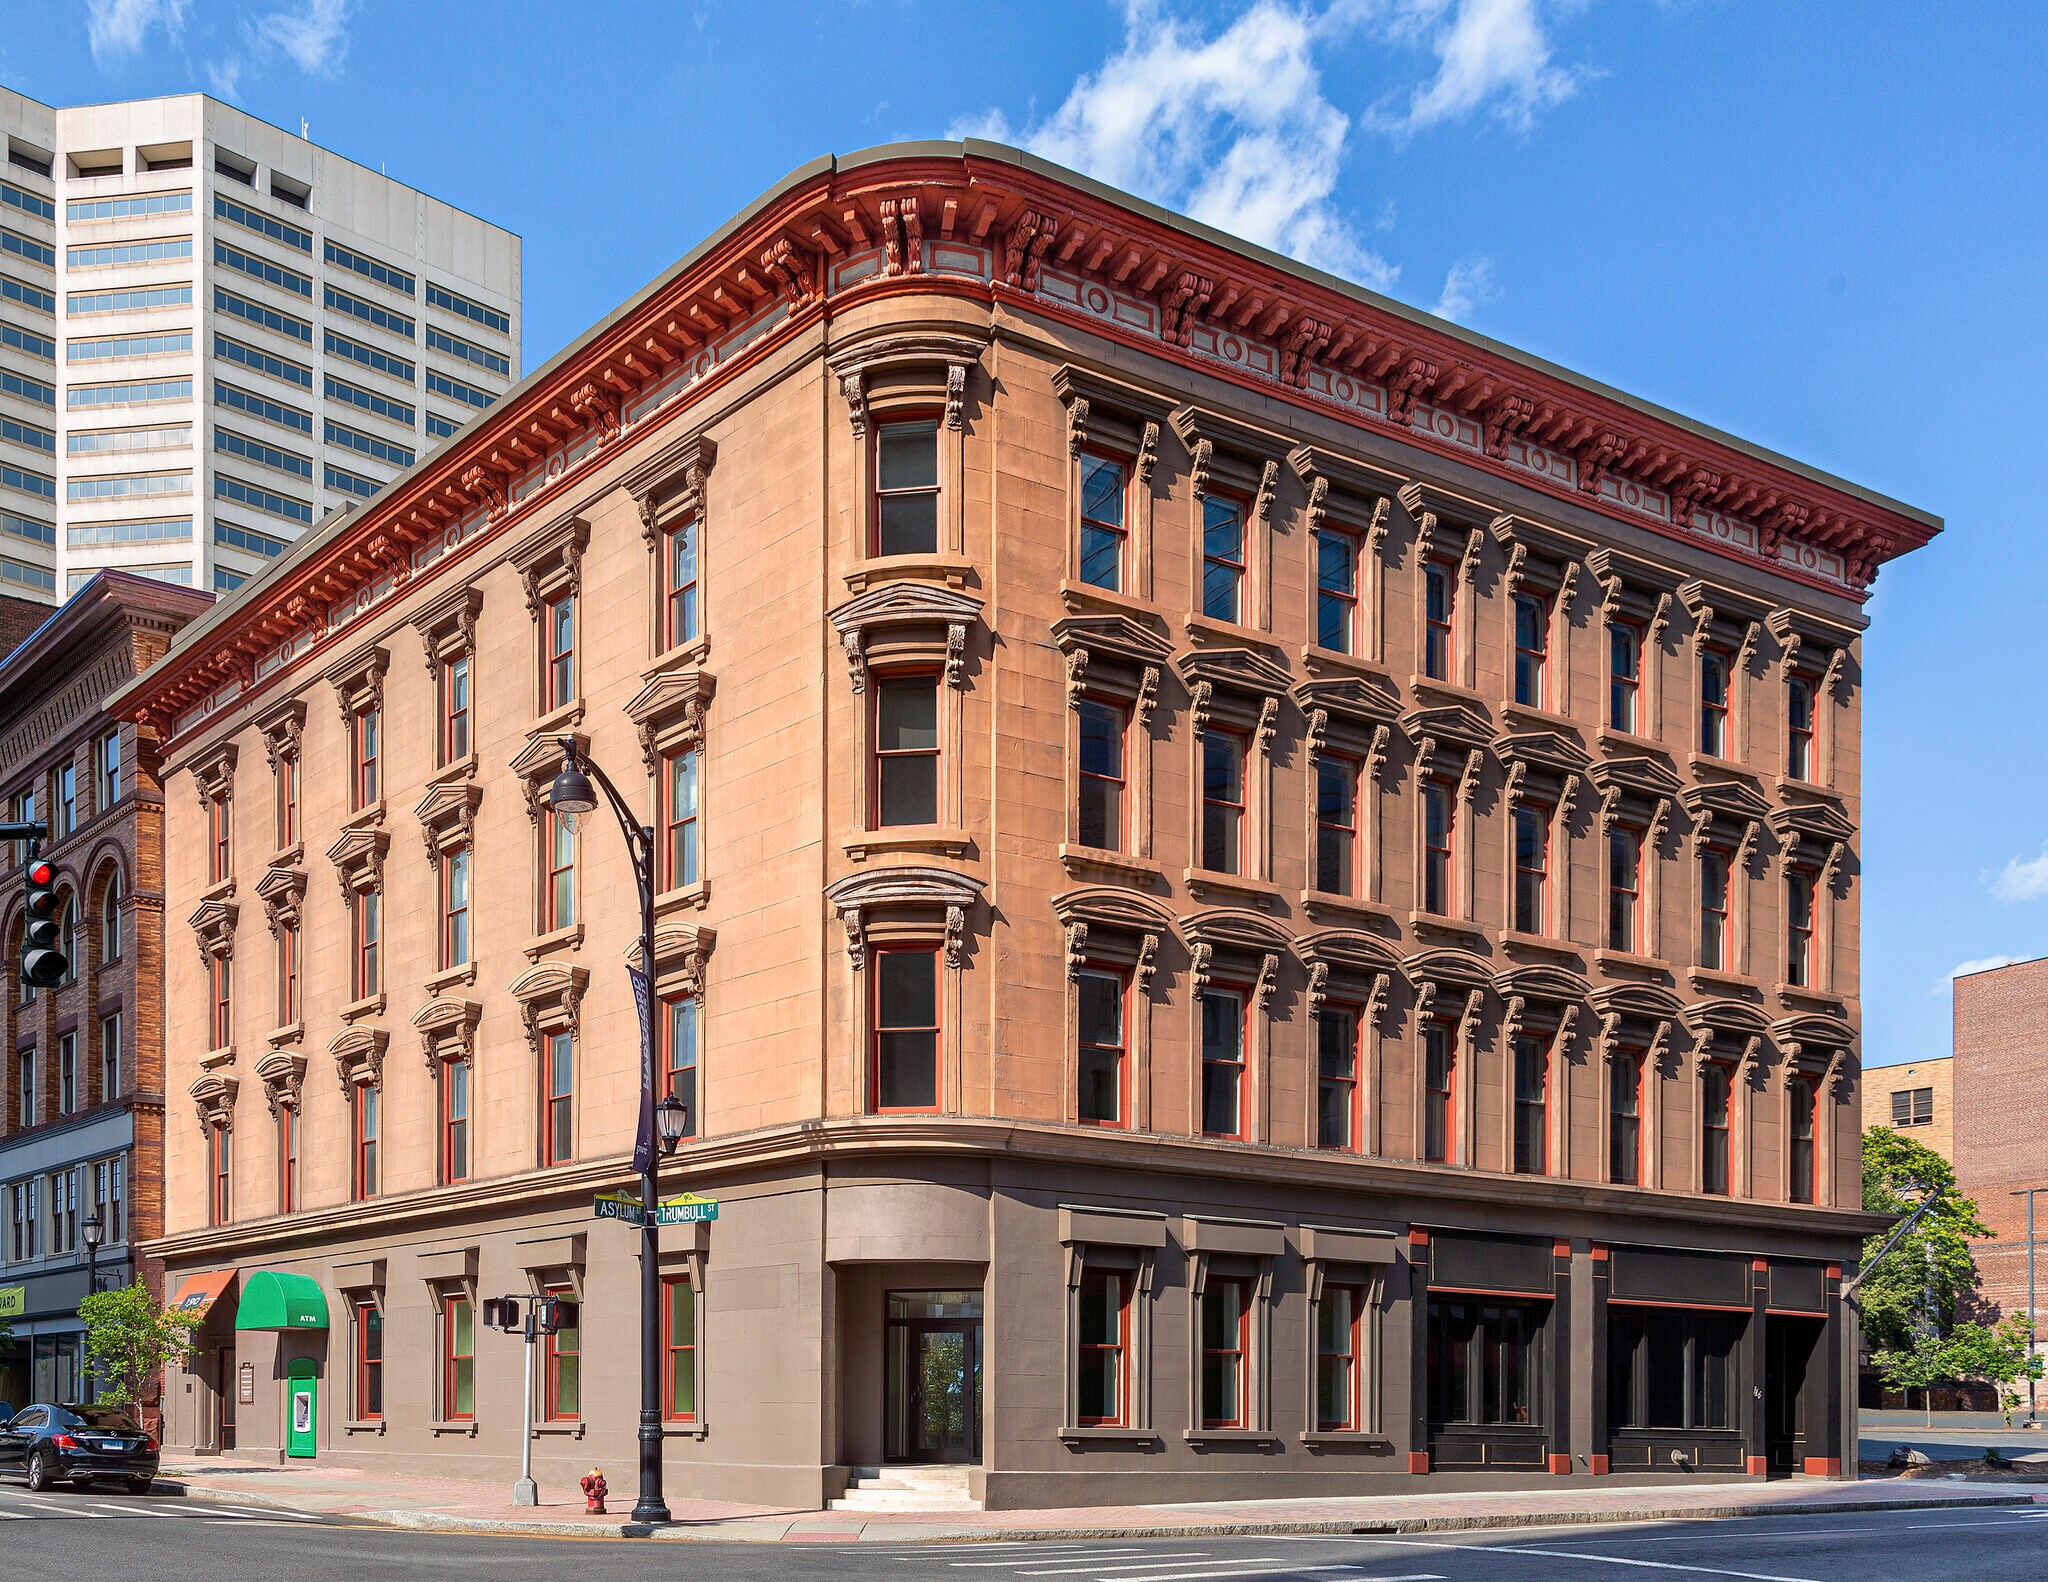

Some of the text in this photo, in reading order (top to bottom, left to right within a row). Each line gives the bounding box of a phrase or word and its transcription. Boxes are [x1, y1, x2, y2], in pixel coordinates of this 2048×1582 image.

[632, 975, 650, 1090] HARTFORD
[600, 1201, 636, 1221] ASYLUM
[661, 1203, 715, 1222] TRUMBULL ST
